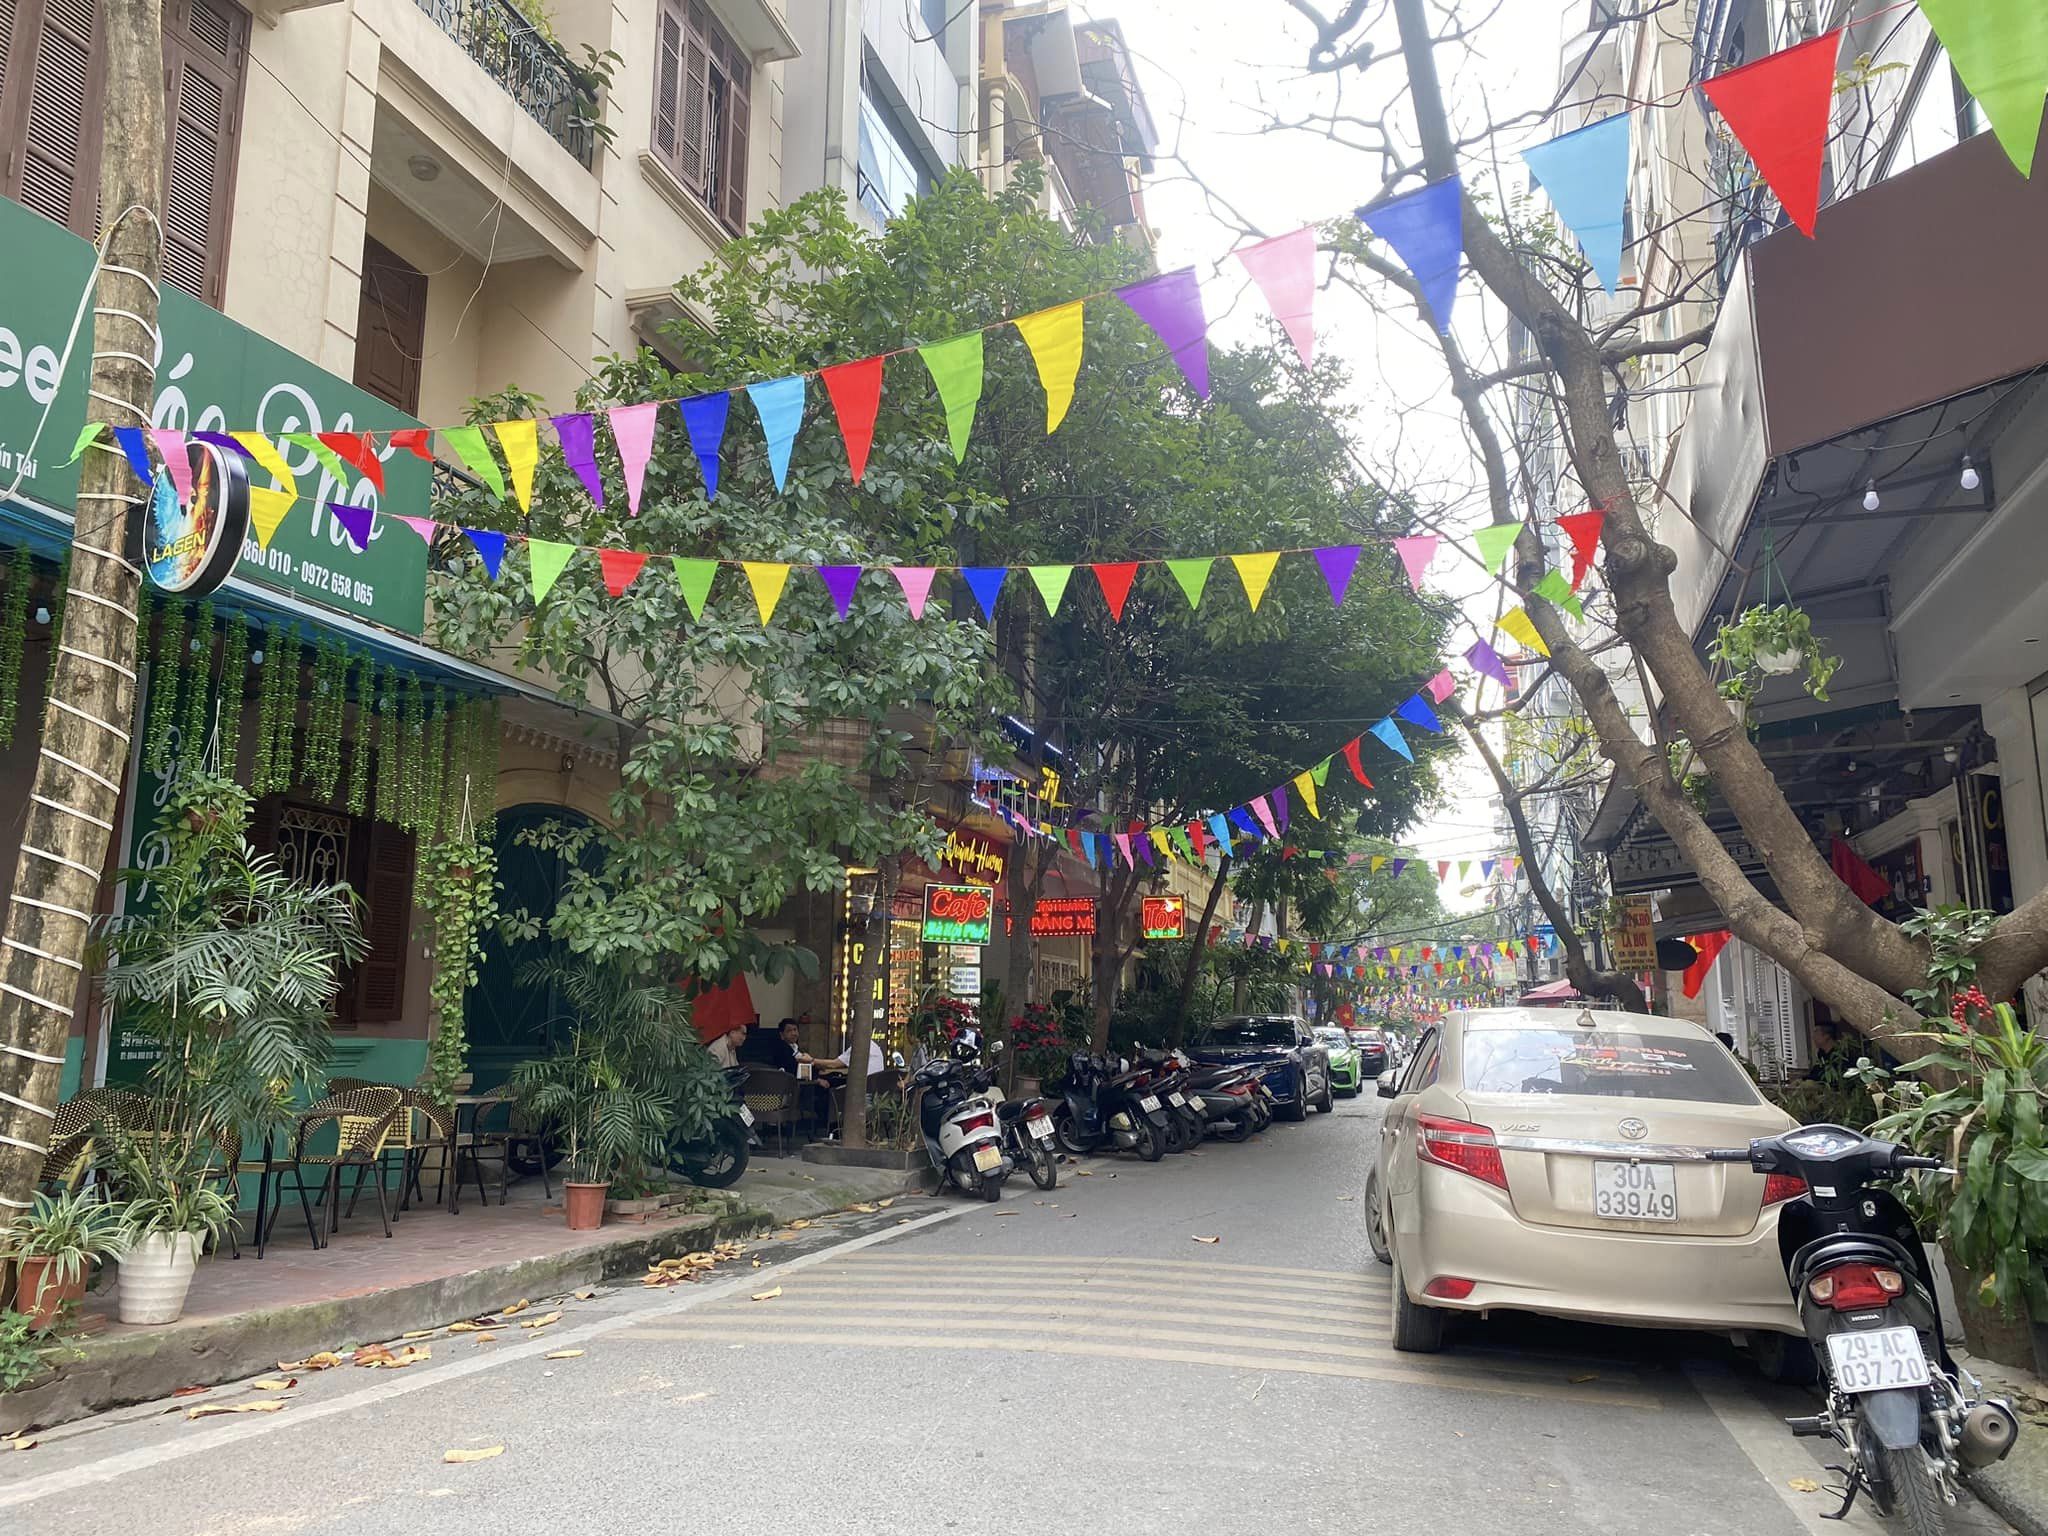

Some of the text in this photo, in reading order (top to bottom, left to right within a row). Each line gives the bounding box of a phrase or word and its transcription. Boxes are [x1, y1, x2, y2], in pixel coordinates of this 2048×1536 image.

[152, 528, 206, 563] LAGEN
[269, 548, 291, 576] 010
[301, 560, 330, 591] 0972
[331, 572, 352, 599] 658
[353, 581, 374, 607] 065
[931, 890, 988, 925] Cafe
[1500, 1122, 1541, 1132] VIOS
[1613, 1163, 1657, 1191] 30A
[1598, 1191, 1674, 1218] 339.49
[1851, 1313, 1880, 1322] HONDA
[1841, 1332, 1908, 1361] 29-AC
[1841, 1357, 1923, 1388] 037.20
